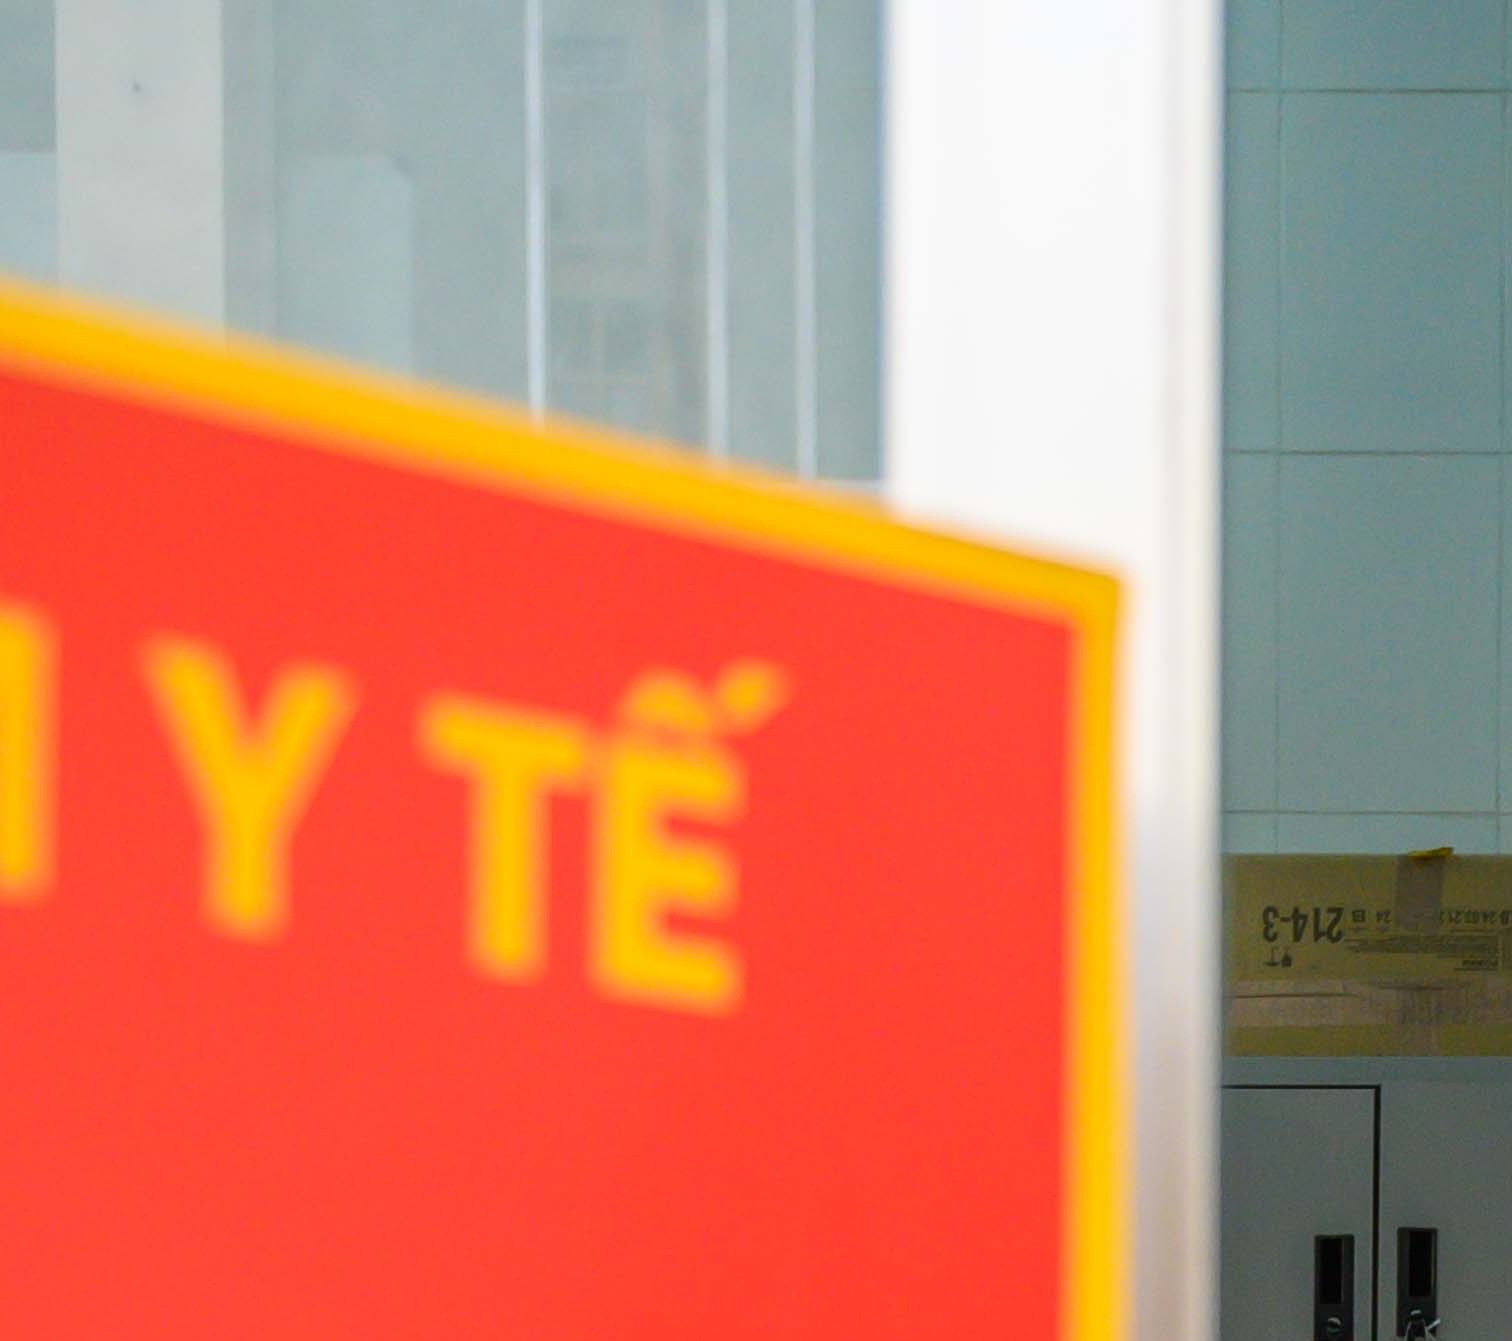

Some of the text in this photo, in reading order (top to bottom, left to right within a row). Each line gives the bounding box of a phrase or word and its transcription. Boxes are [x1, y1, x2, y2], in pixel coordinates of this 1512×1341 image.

[140, 634, 356, 935] Y
[425, 662, 784, 1013] TẾ
[1261, 907, 1346, 944] 214-3
